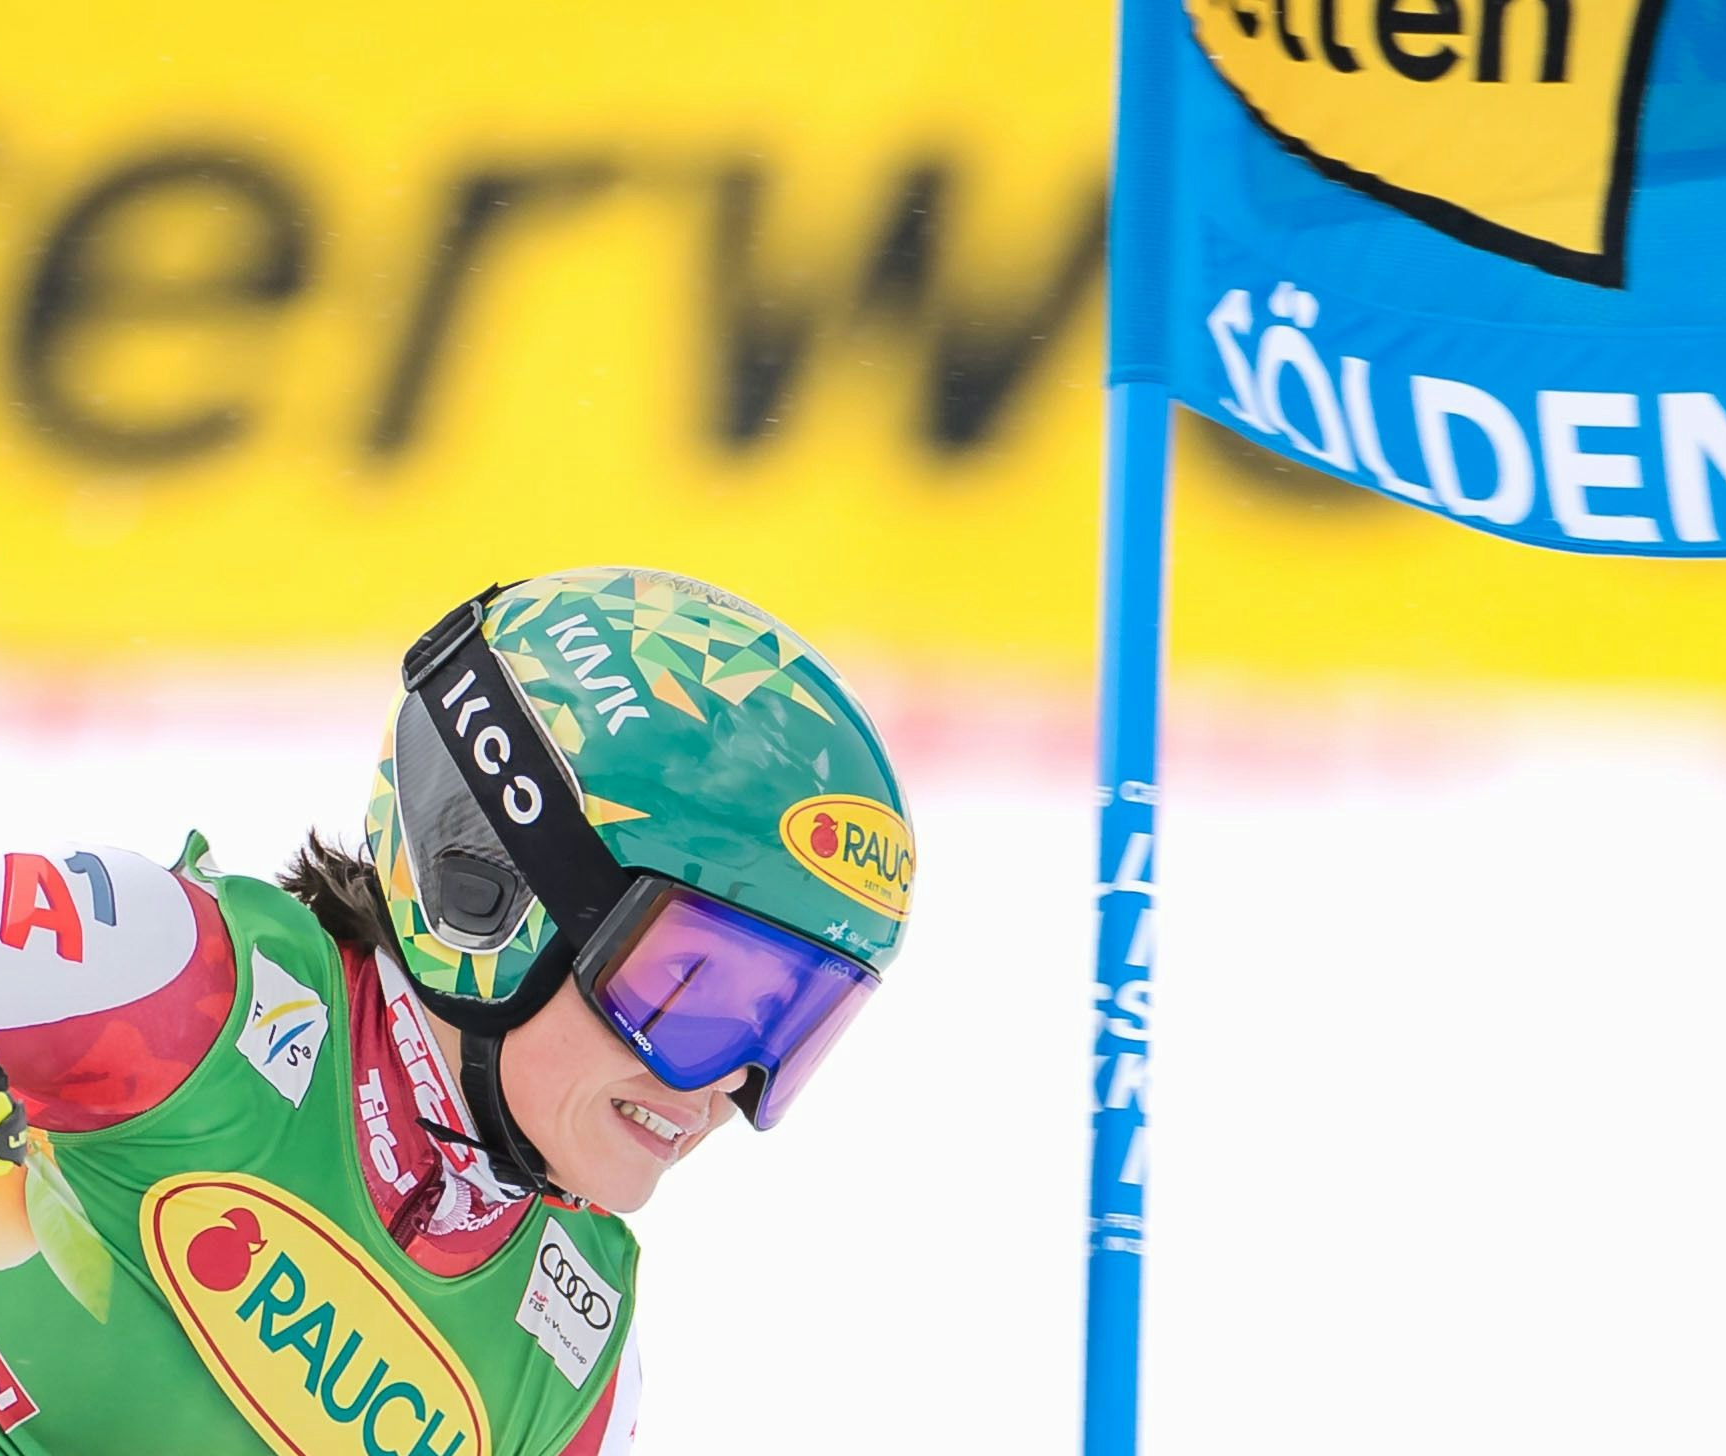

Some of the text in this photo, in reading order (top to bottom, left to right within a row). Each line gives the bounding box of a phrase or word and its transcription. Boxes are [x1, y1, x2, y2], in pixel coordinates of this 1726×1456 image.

[546, 613, 650, 736] KASK
[0, 852, 117, 963] A1
[842, 821, 914, 893] RAUC
[358, 1068, 419, 1197] Tirol
